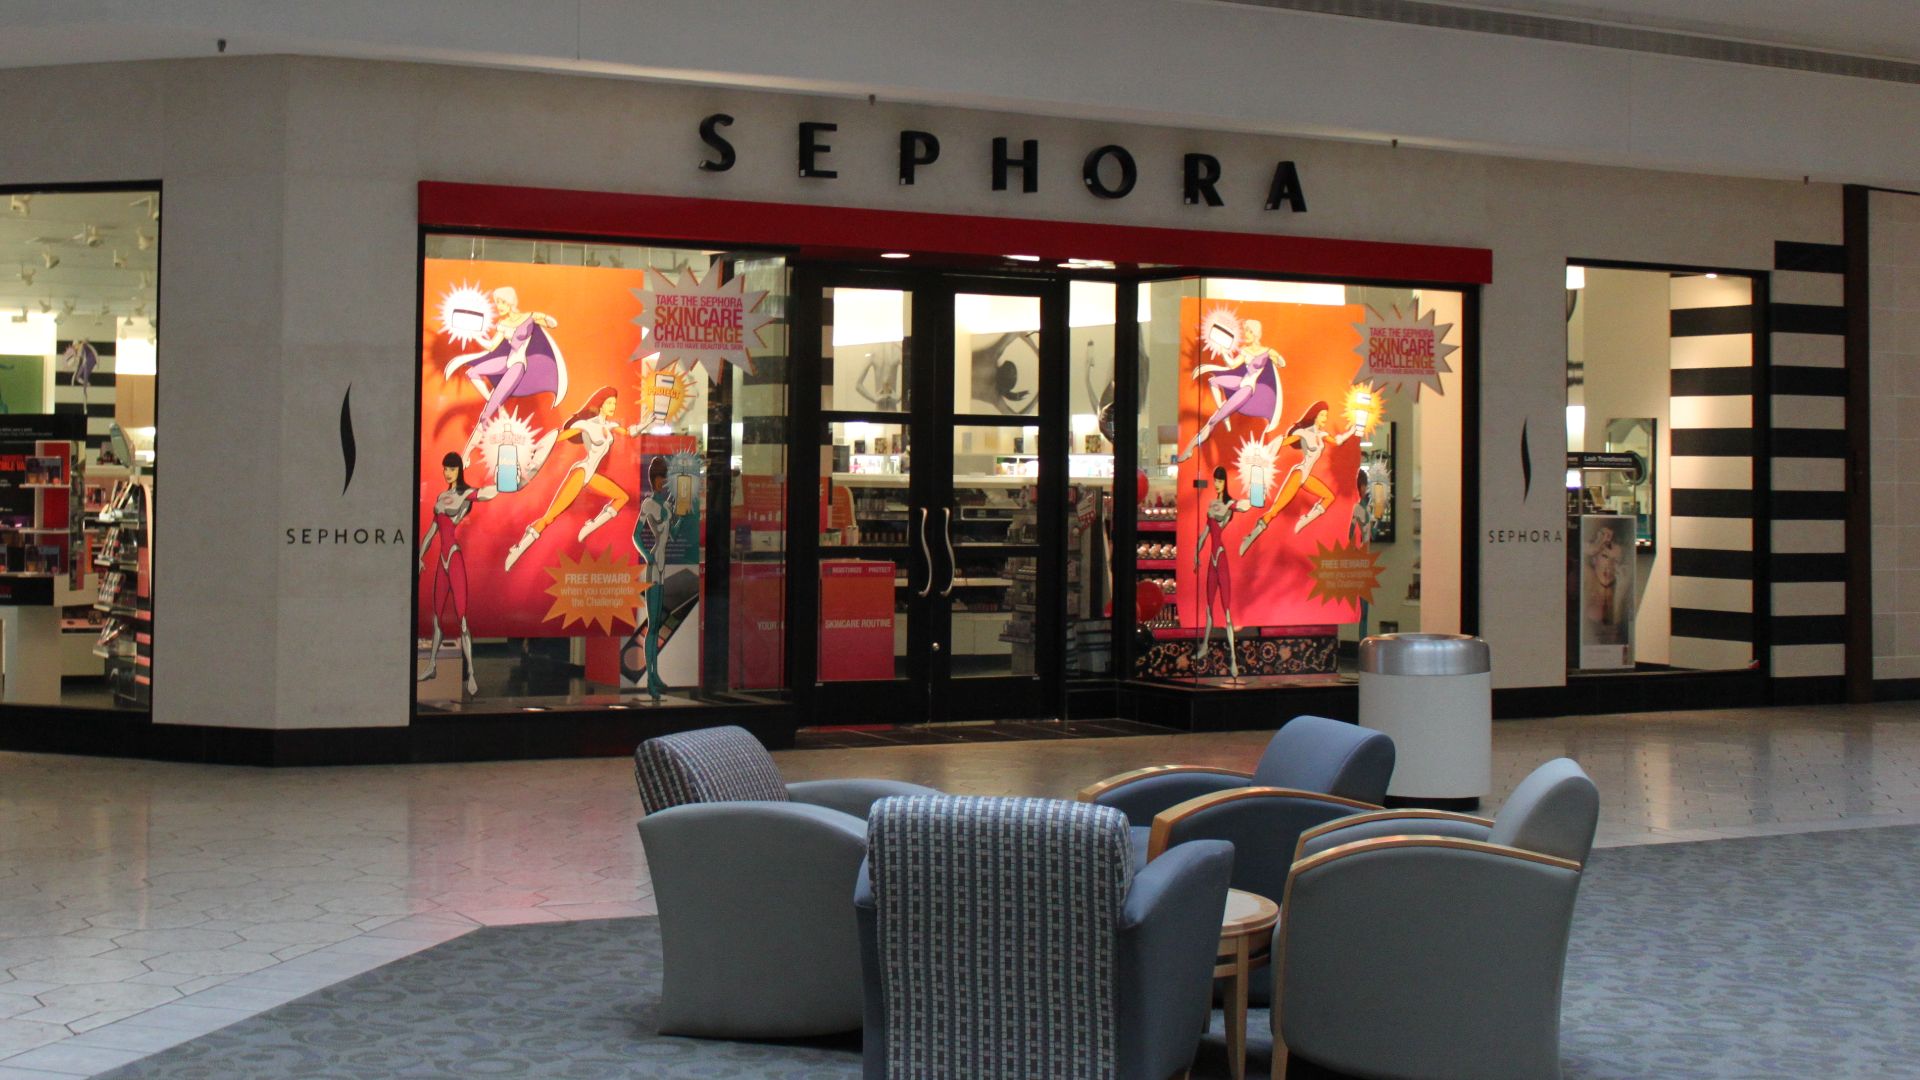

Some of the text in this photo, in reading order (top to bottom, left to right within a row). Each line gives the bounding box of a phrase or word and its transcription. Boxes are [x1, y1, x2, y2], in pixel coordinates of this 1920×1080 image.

[699, 114, 1307, 213] SEPHORA
[656, 295, 742, 308] TAKE THE SEPHORA
[655, 306, 743, 329] SKINCARE
[654, 324, 744, 343] CHALLENGE
[1370, 328, 1434, 338] TAKE THE SEPHORA
[1369, 337, 1434, 357] SKINCARE
[1369, 352, 1435, 369] CHALLENGE
[286, 528, 405, 544] SEPHORA
[1488, 529, 1562, 543] SEPHORA
[565, 573, 630, 584] FREE REWARD
[561, 586, 582, 595] when
[584, 588, 598, 598] you
[825, 619, 860, 629] SKINCARE
